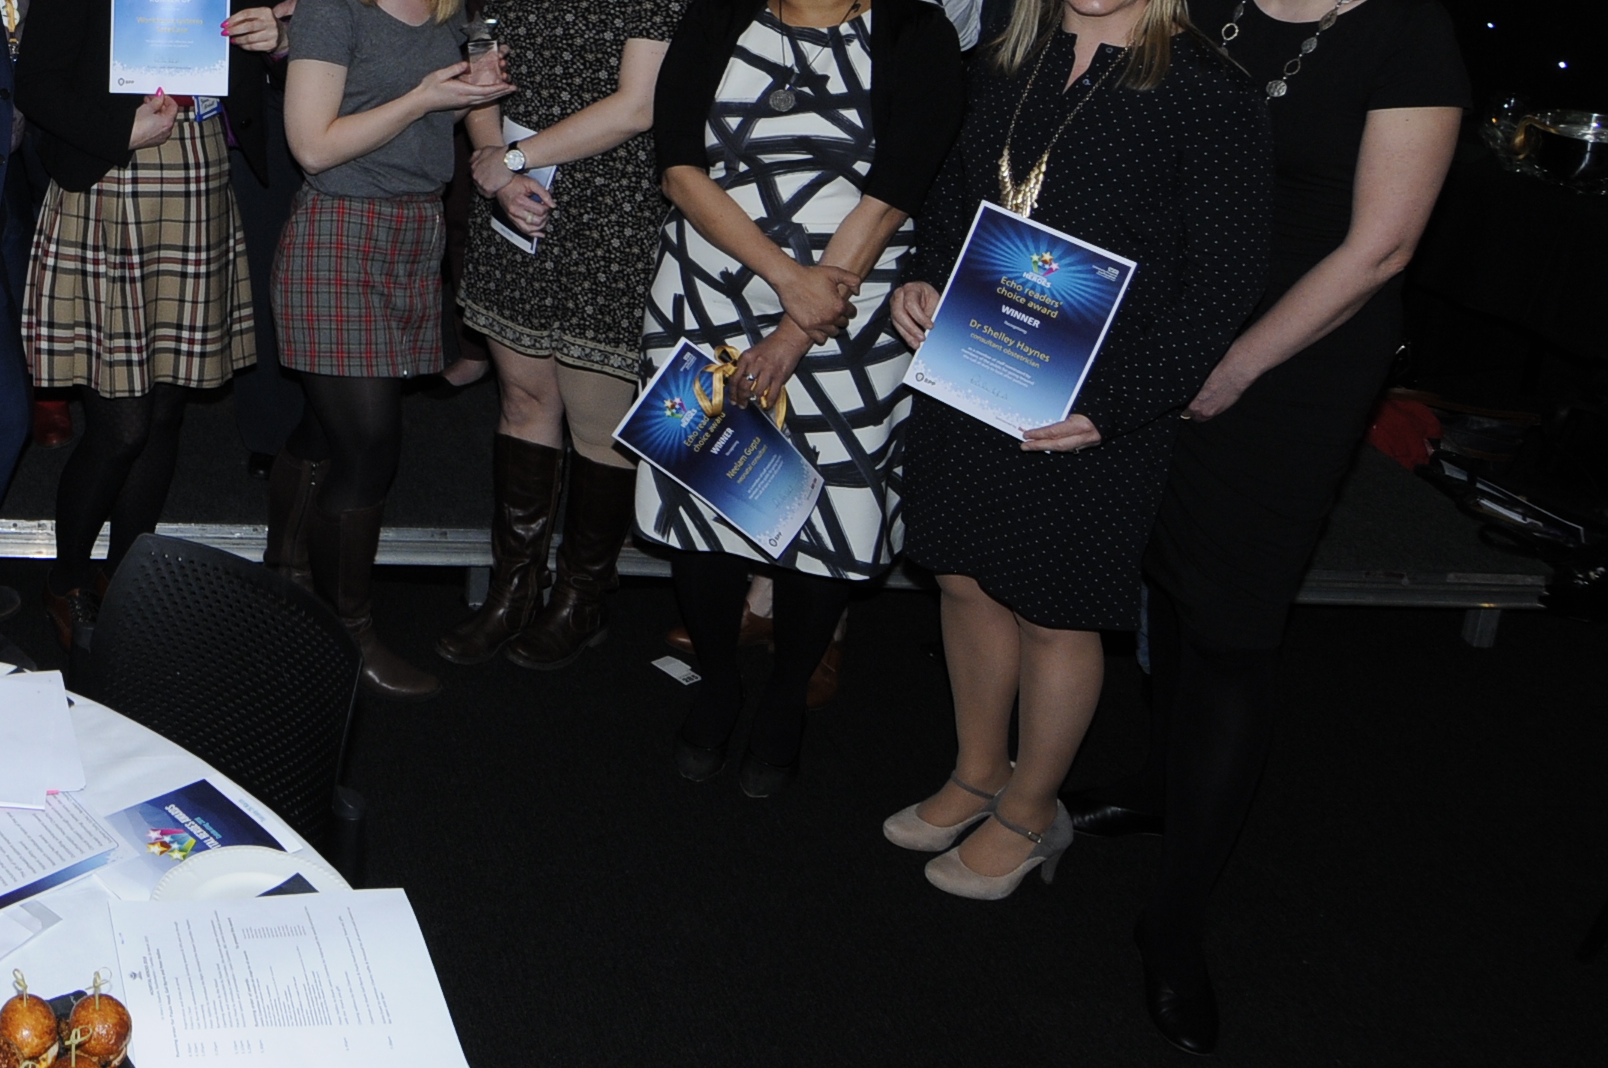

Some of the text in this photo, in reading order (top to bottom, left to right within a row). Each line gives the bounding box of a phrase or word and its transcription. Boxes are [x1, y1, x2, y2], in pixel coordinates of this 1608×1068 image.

[1000, 276, 1023, 291] Echo
[996, 285, 1058, 318] choice award
[1000, 305, 1040, 328] WINNER
[969, 319, 1051, 362] Dr Shelley Haynes
[969, 332, 1002, 351] consultant
[1003, 347, 1040, 368] obstetrician
[683, 429, 699, 446] Echo
[692, 431, 710, 452] choice
[711, 426, 734, 455] WINNER
[726, 453, 747, 479] Neelam
[743, 435, 761, 456] Gupta
